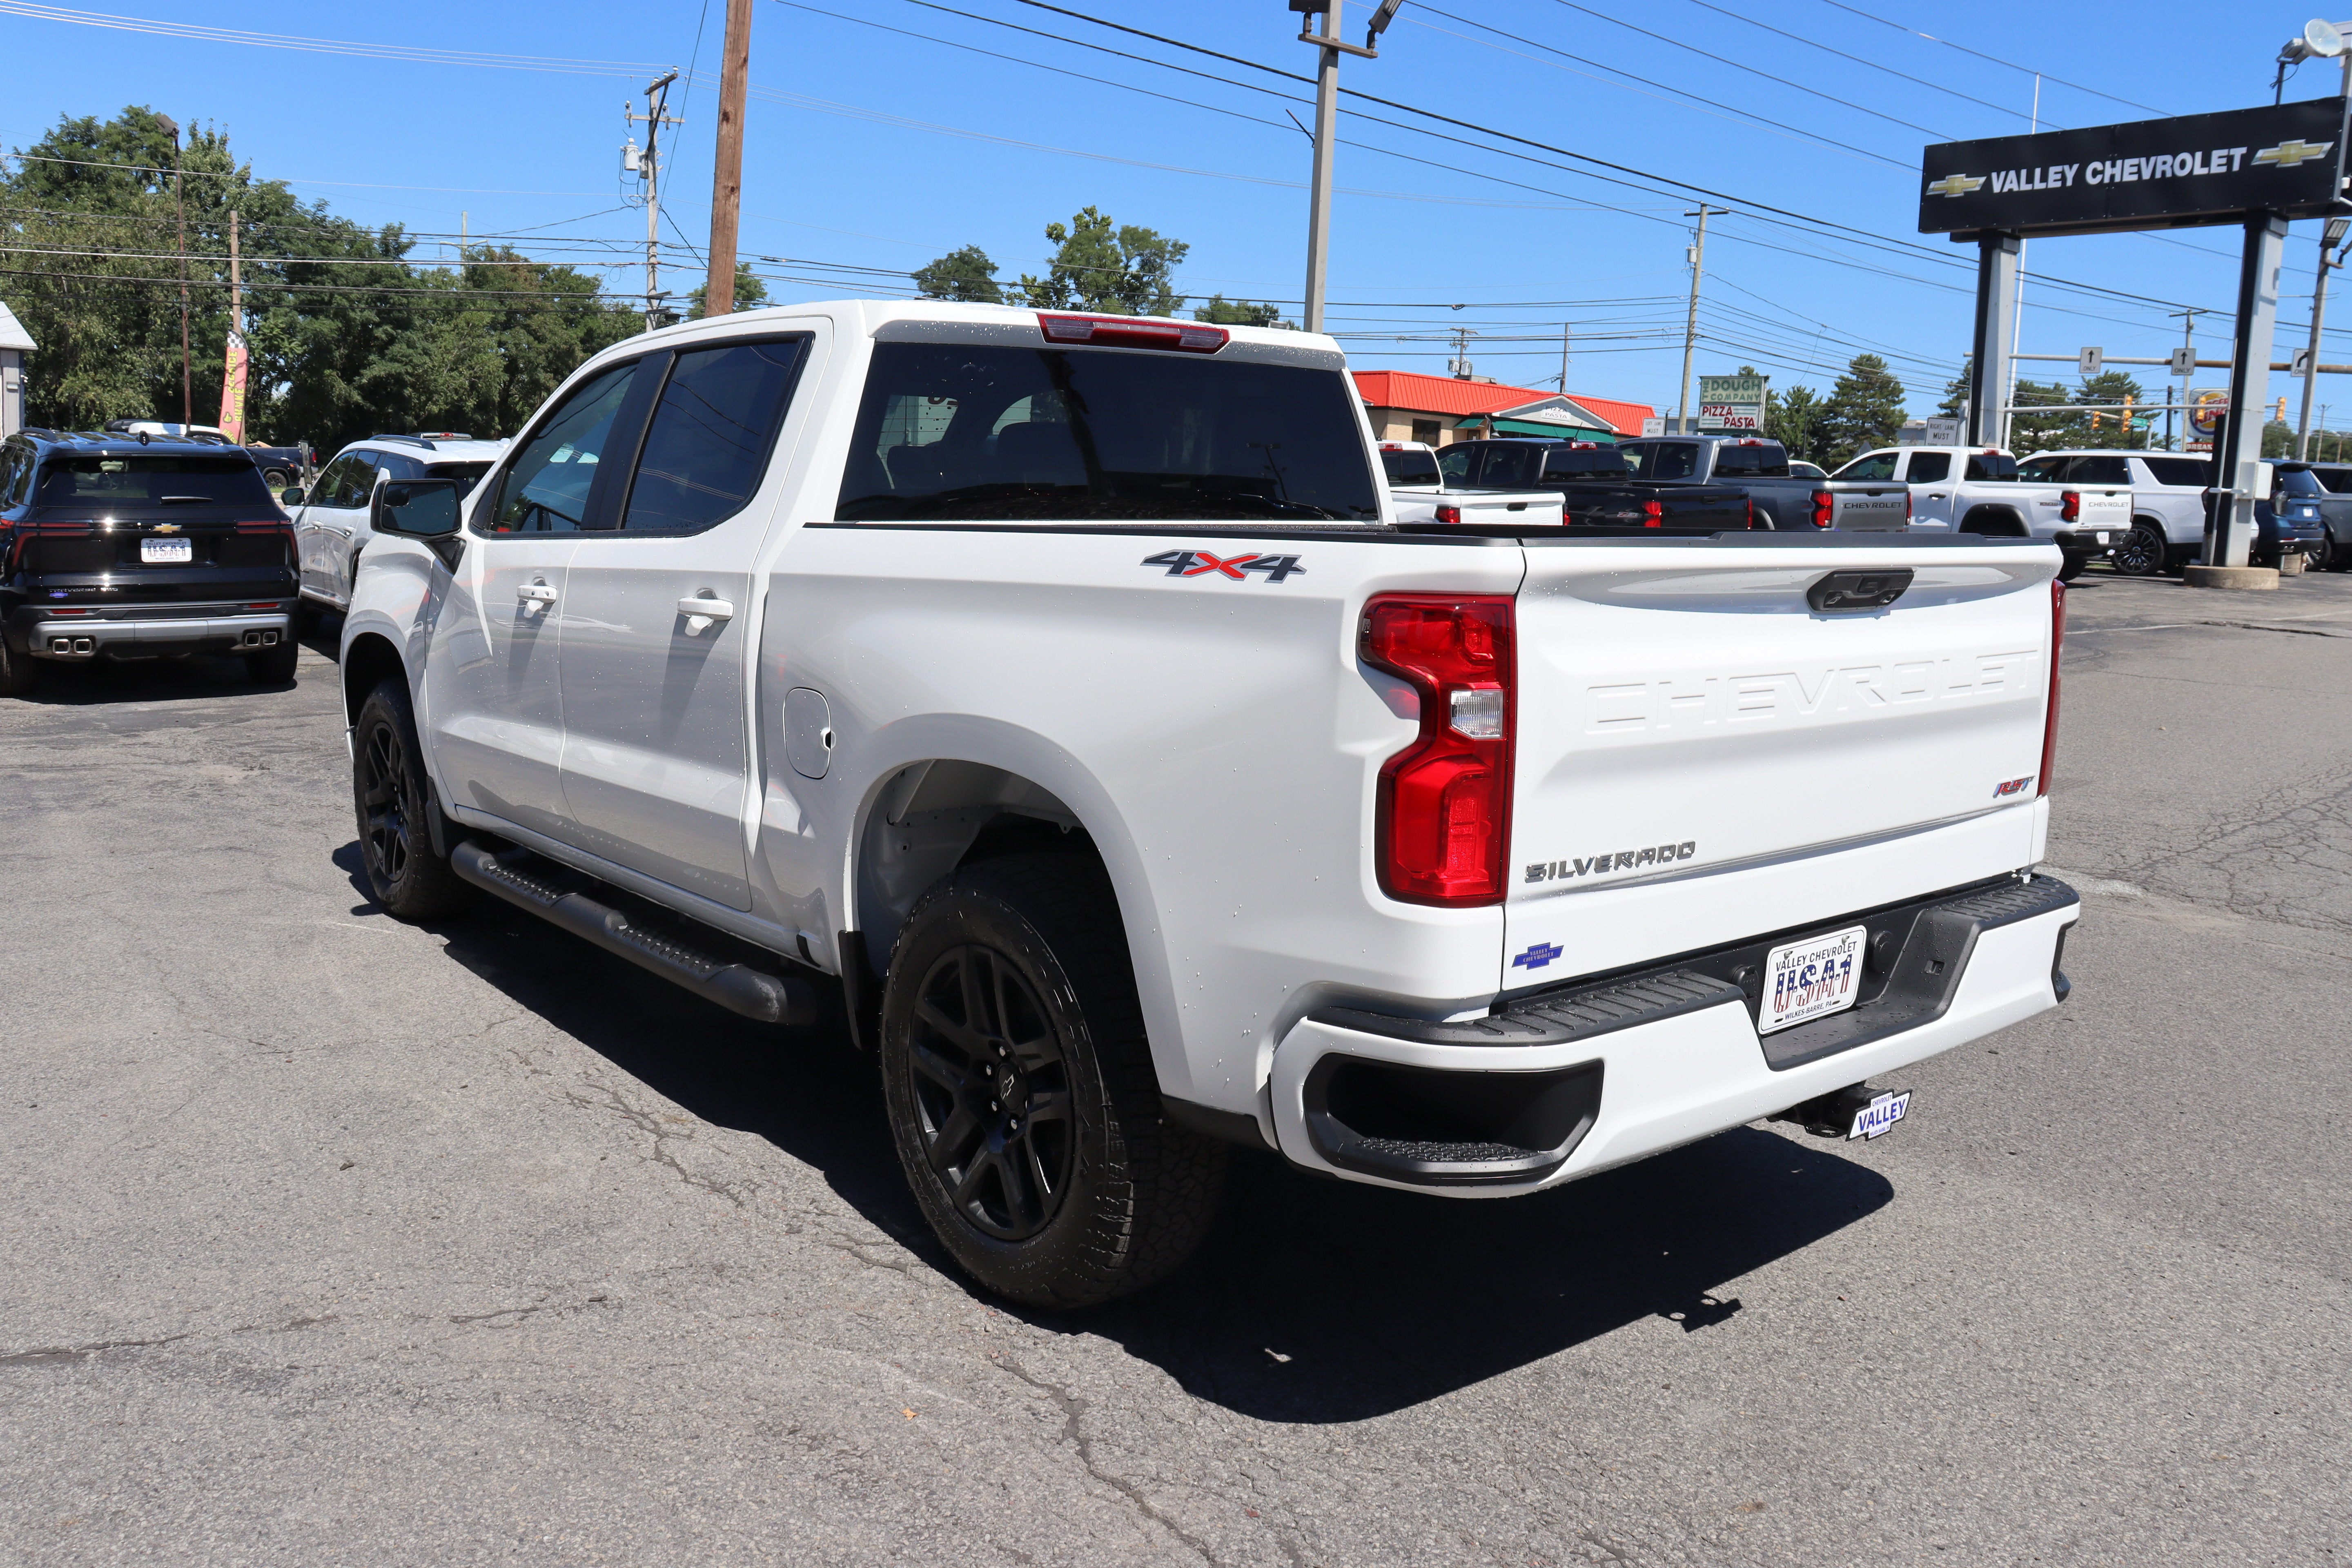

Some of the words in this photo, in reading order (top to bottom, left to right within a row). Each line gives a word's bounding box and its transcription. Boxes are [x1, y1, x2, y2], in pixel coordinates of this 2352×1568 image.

[1991, 163, 2080, 193] VALLEY
[2085, 146, 2248, 185] CHEVROLET
[1711, 379, 1762, 391] DOUGH
[1702, 406, 1733, 416] PIZZA
[1724, 417, 1755, 428] PASTA
[1933, 432, 1950, 440] MUST
[1585, 650, 2038, 735] CHEVROLET
[1993, 775, 2035, 799] RST
[1525, 841, 1695, 883] SILVERADO
[1523, 951, 1554, 962] CHEVROLET
[1776, 954, 1807, 972] VALLEY
[1809, 941, 1857, 962] CHEVROLET
[1785, 1003, 1825, 1020] WILKES-BARRE,
[1872, 1094, 1892, 1107] CHEVROLET
[1858, 1098, 1906, 1132] VALLEY
